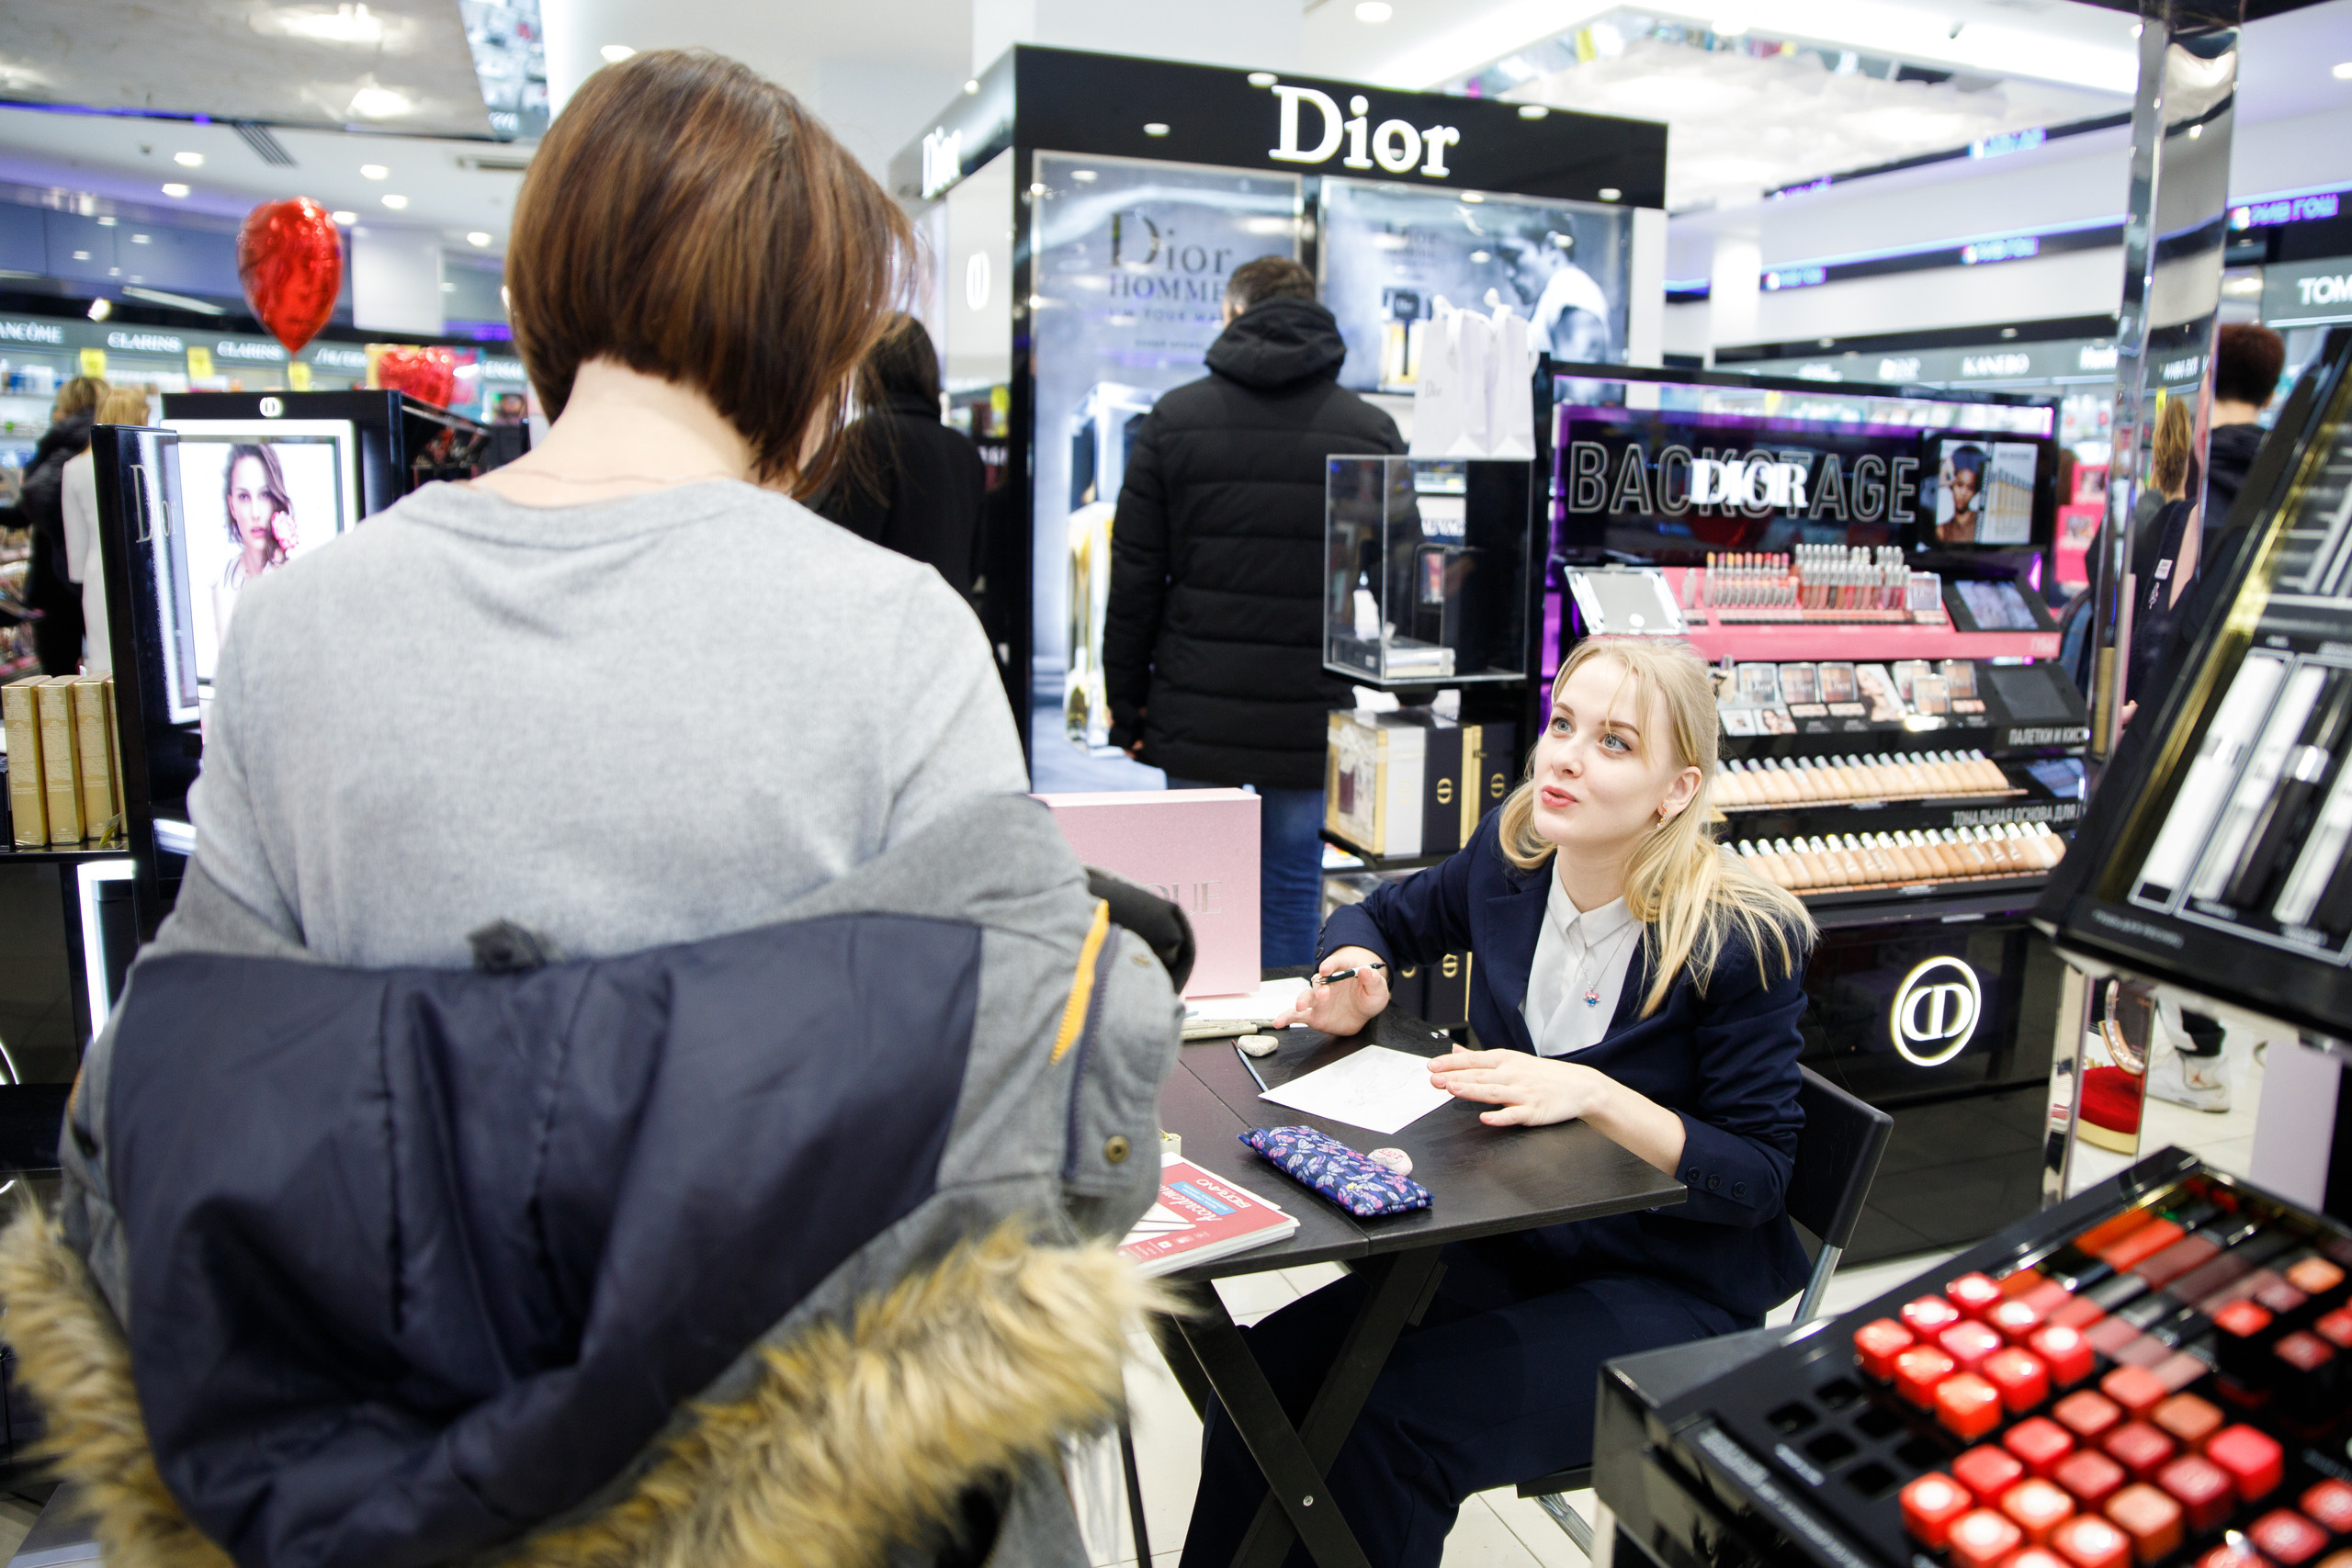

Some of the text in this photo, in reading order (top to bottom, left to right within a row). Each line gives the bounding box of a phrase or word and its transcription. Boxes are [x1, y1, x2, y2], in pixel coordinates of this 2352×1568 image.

[1268, 85, 1461, 178] Dior
[1111, 212, 1232, 274] Dior
[107, 332, 182, 353] CLARINS
[217, 341, 285, 361] CLARINS
[1690, 458, 1808, 509] DIOR
